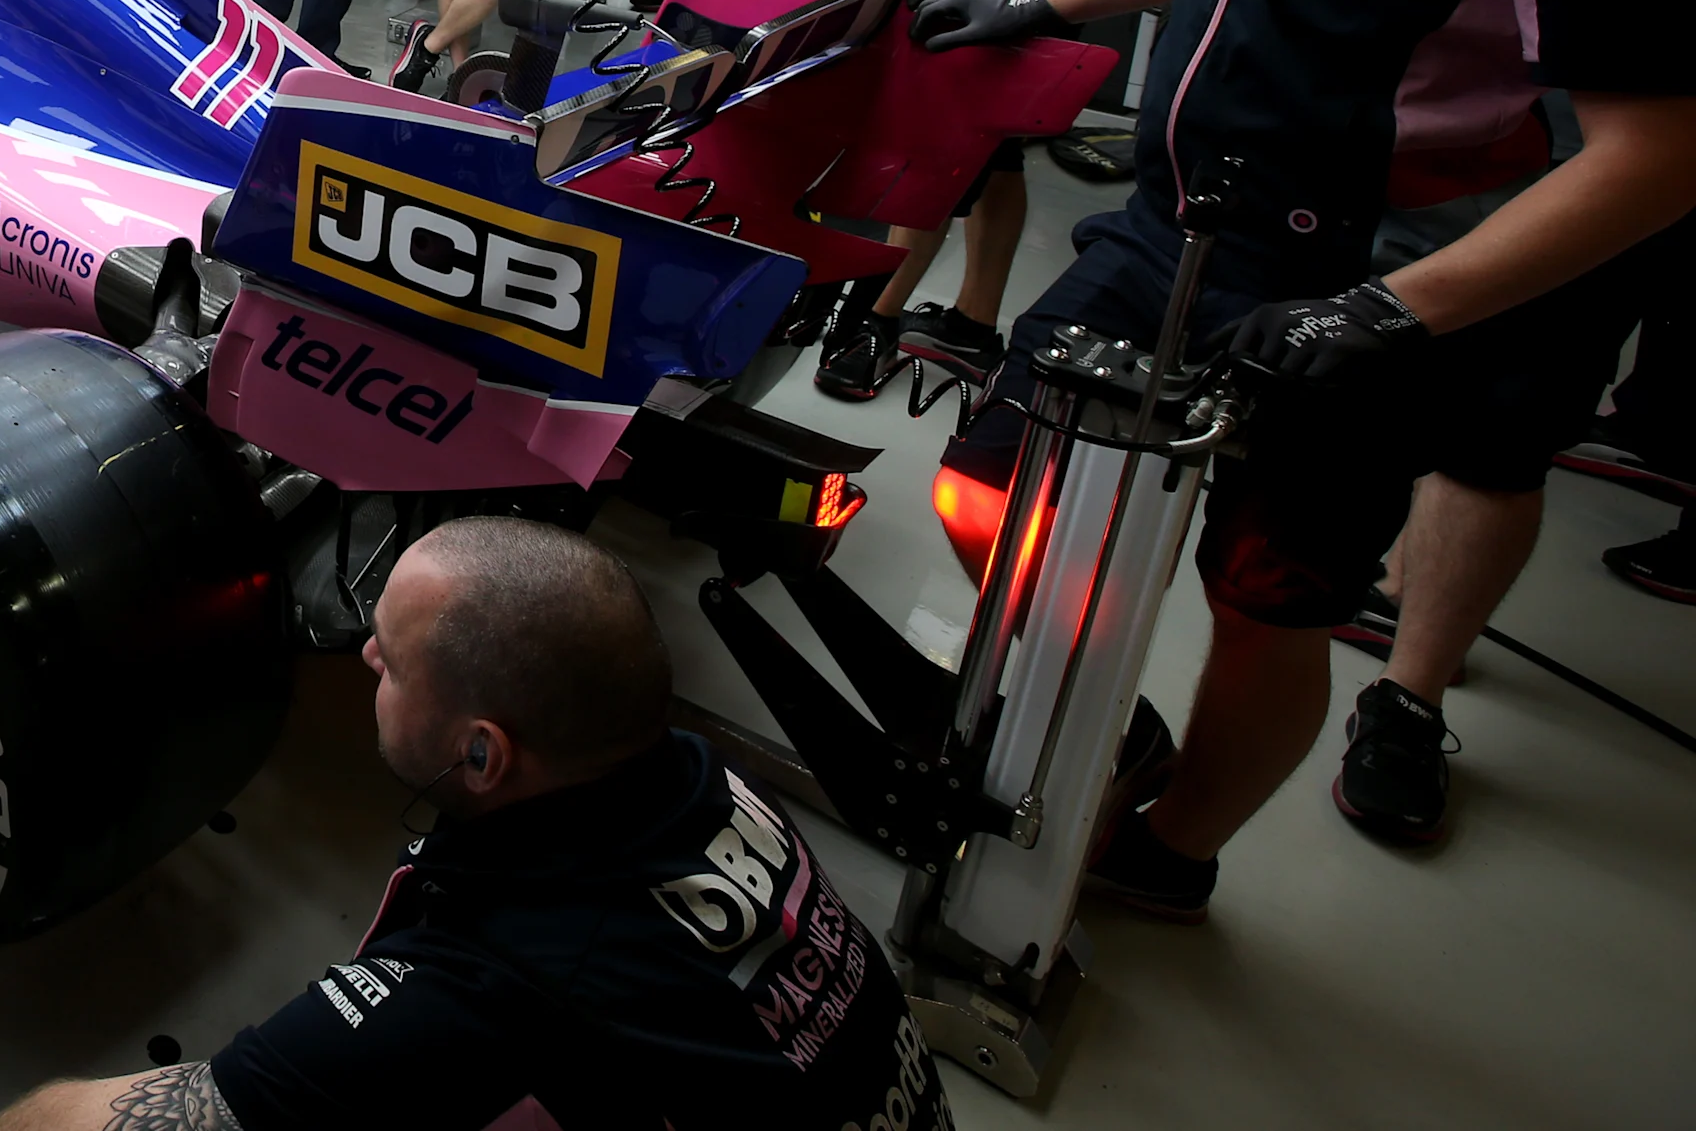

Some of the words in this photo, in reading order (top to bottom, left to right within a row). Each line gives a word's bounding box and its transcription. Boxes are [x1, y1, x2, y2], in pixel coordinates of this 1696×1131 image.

[317, 189, 584, 332] JCB
[260, 315, 475, 445] telcel
[1285, 314, 1348, 348] HyFlex
